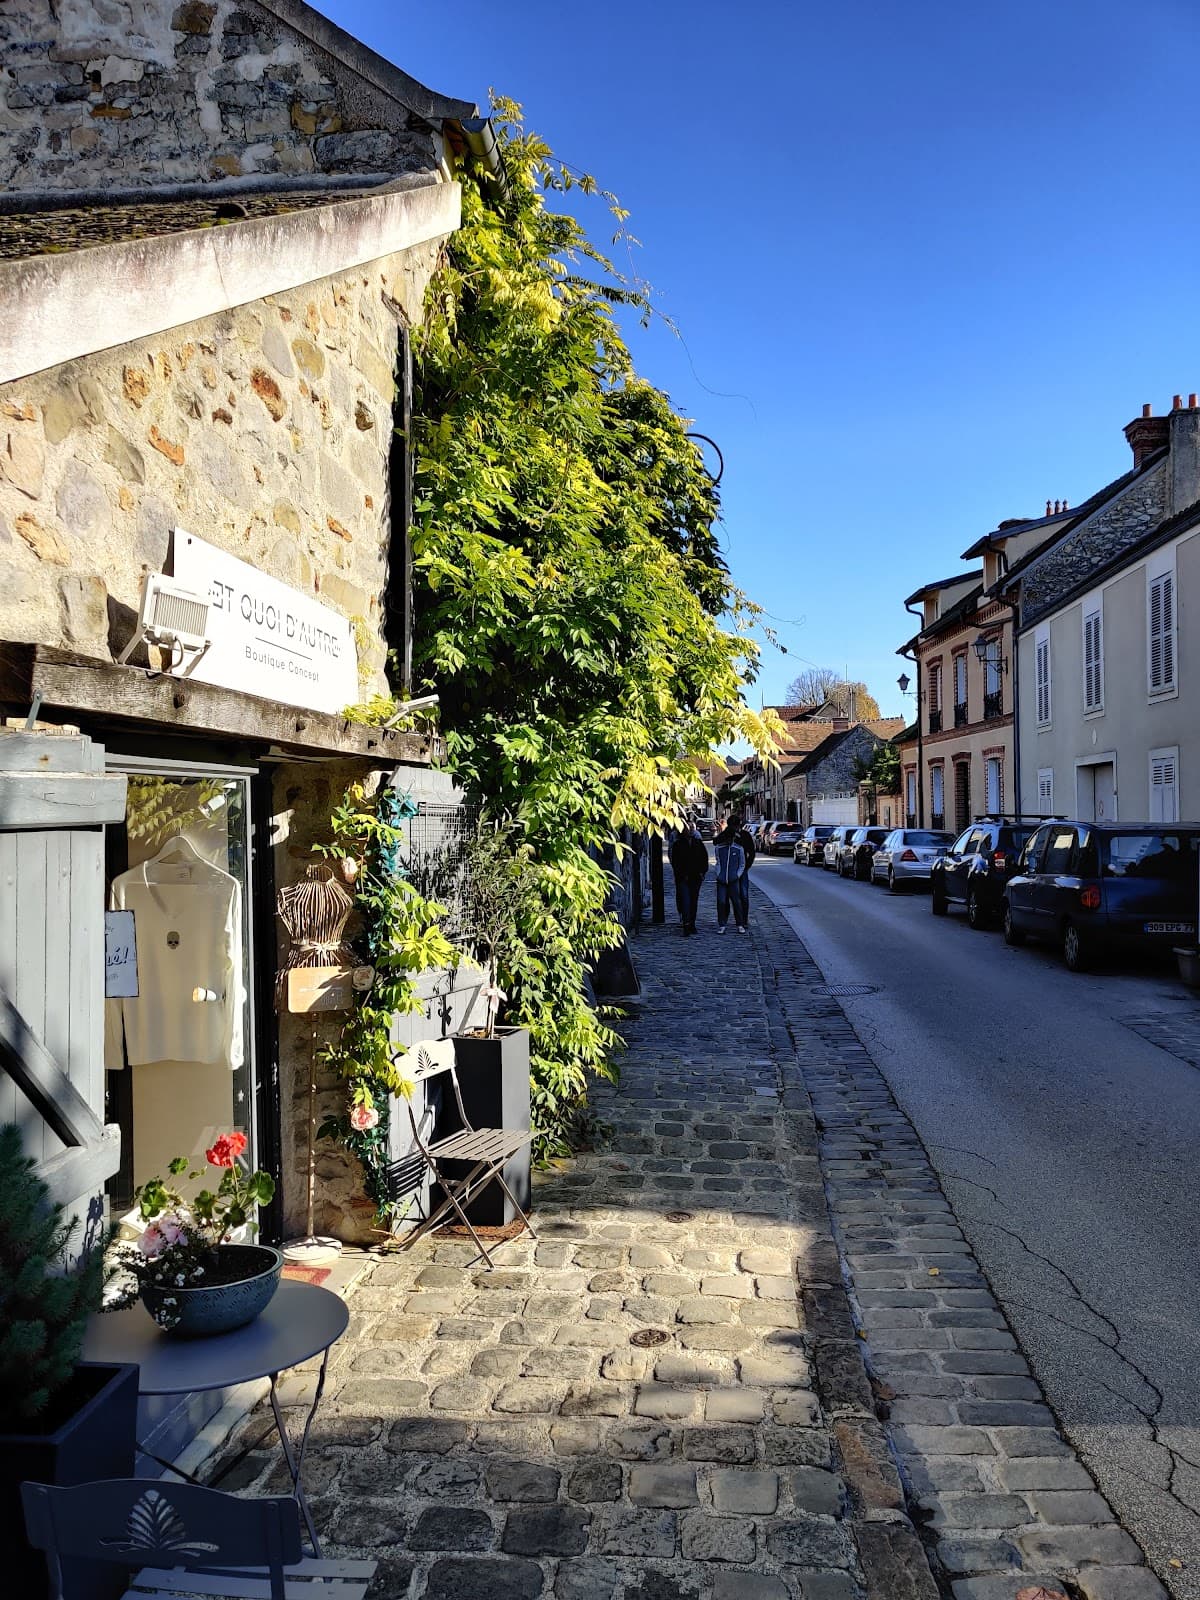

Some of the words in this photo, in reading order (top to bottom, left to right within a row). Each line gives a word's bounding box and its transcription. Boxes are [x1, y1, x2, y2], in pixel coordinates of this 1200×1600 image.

[241, 594, 281, 633] QUOI
[245, 645, 286, 670] Boutique
[288, 661, 319, 682] Concept
